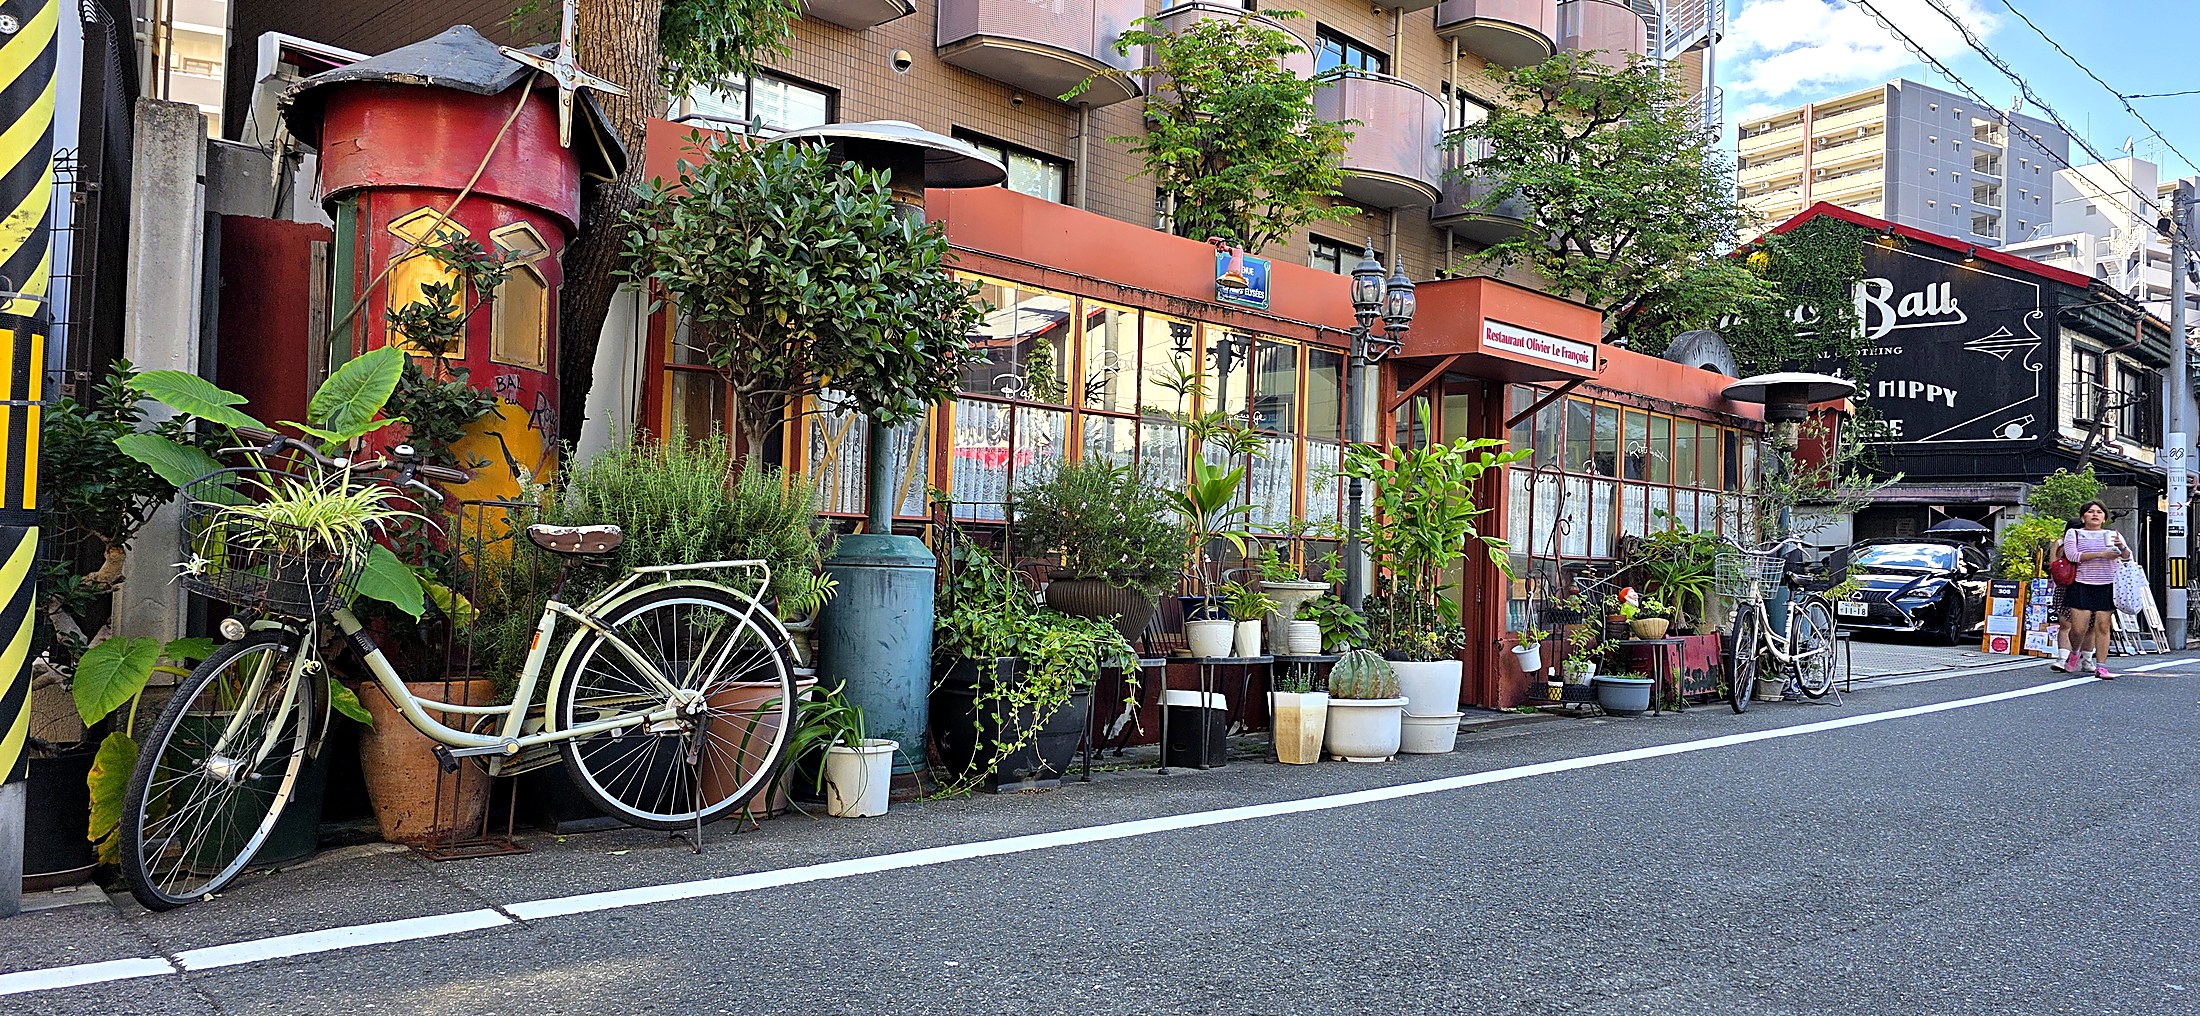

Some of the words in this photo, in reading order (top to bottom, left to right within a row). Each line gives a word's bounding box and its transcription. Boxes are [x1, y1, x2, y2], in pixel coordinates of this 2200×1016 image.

[1851, 277, 1967, 340] Ball
[1487, 327, 1524, 347] Restaurant
[1526, 337, 1551, 354] Olivier
[1552, 343, 1561, 357] Le
[1561, 346, 1589, 364] François
[496, 375, 526, 392] BAL
[1879, 380, 1958, 408] HIPPY
